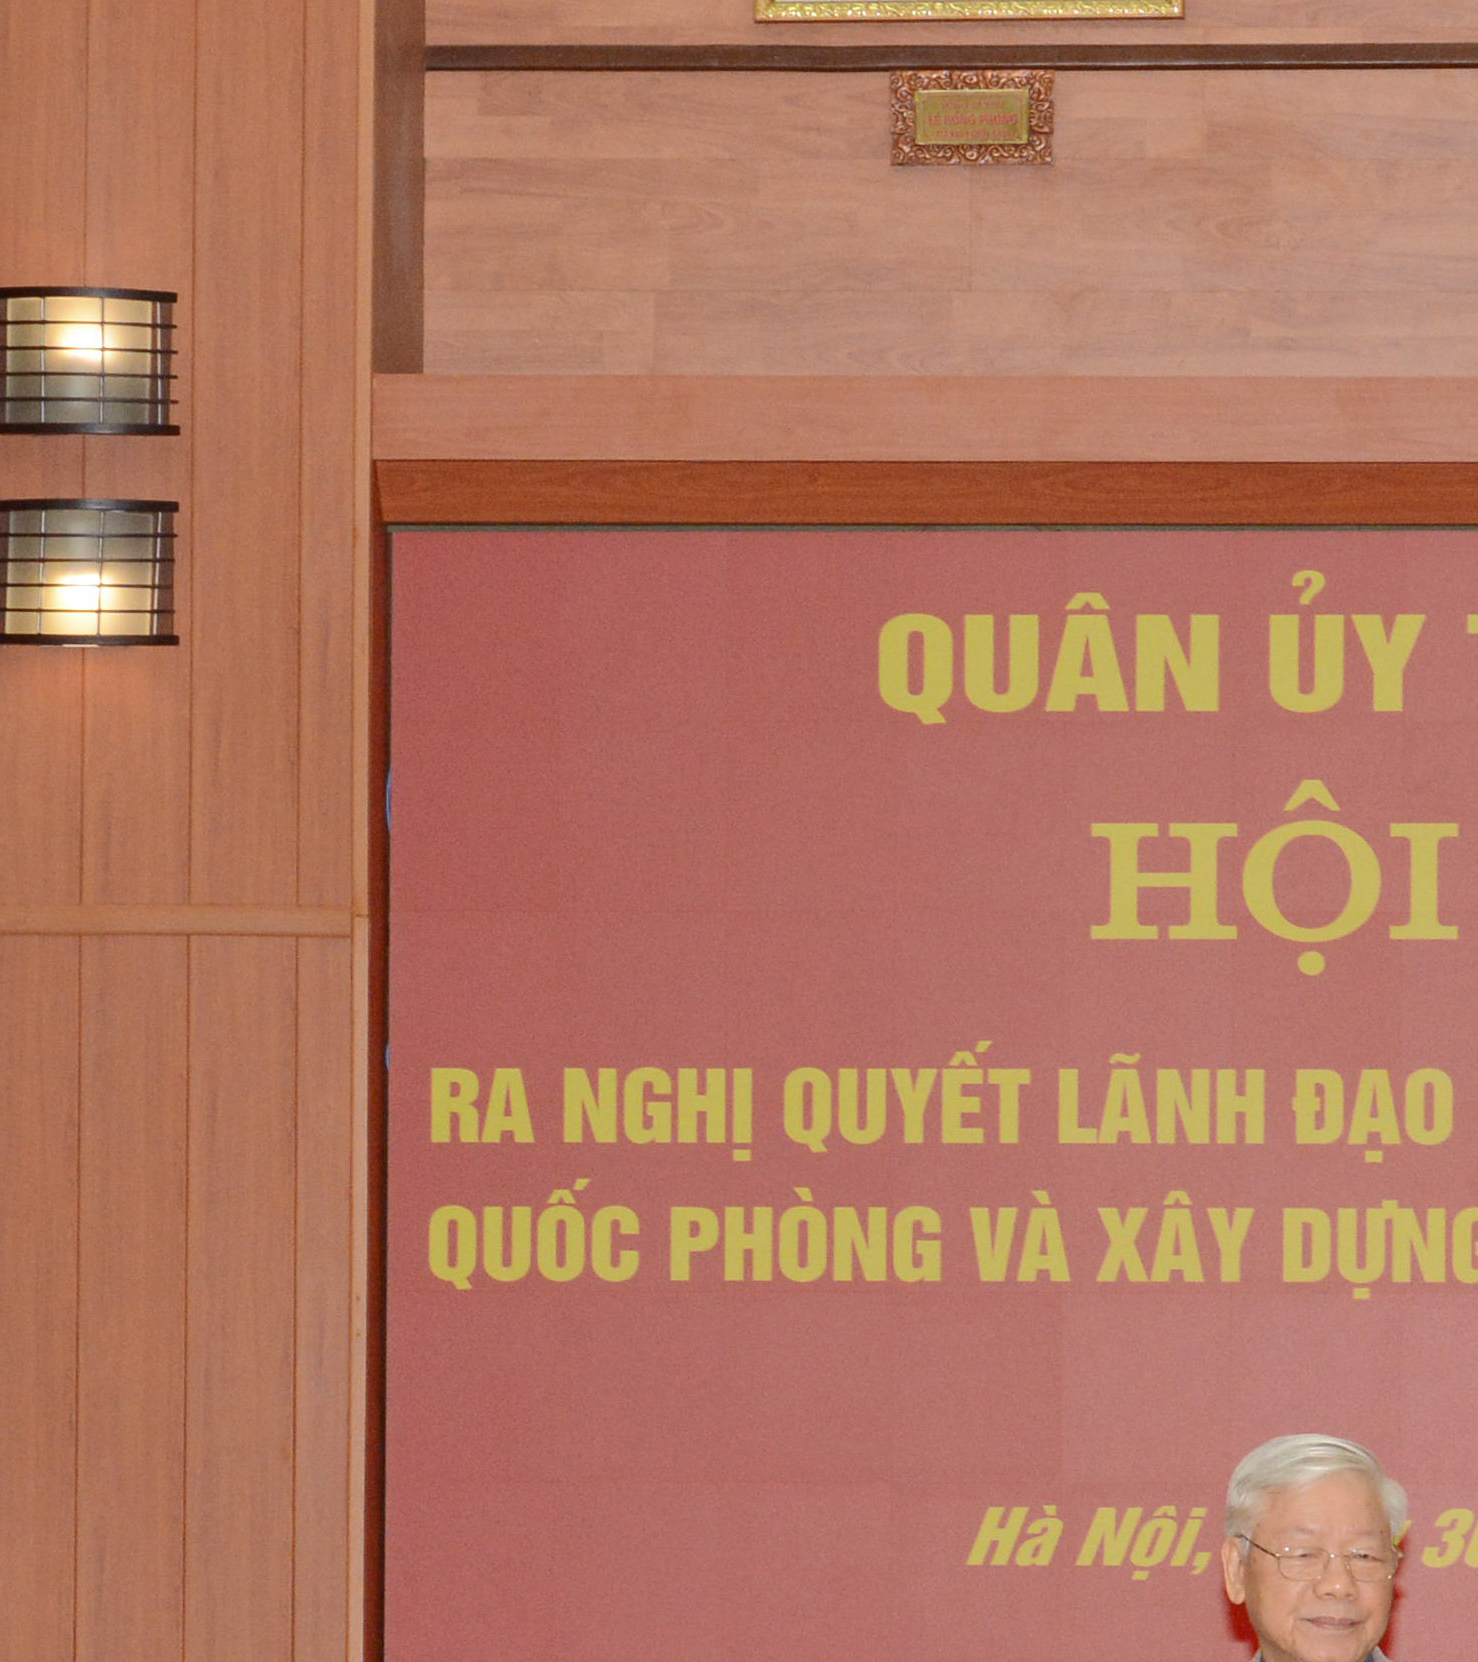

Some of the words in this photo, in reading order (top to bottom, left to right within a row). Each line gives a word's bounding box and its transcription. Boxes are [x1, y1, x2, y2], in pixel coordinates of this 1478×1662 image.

[878, 592, 1220, 725] QUÂN
[1269, 570, 1426, 713] ỦY
[1090, 779, 1459, 975] HỘI
[431, 1067, 535, 1144] RA
[564, 1067, 754, 1162] NGHỊ
[783, 1040, 1031, 1153] QUYẾT
[1058, 1053, 1266, 1144] LÃNH
[1293, 1068, 1453, 1163] ĐẠO
[429, 1178, 640, 1290] QUỐC
[670, 1187, 942, 1282] PHÒNG
[970, 1190, 1071, 1282] VÀ
[1098, 1190, 1254, 1283] XÂY
[966, 1505, 1064, 1566] Hà
[1075, 1505, 1212, 1581] Nội,
